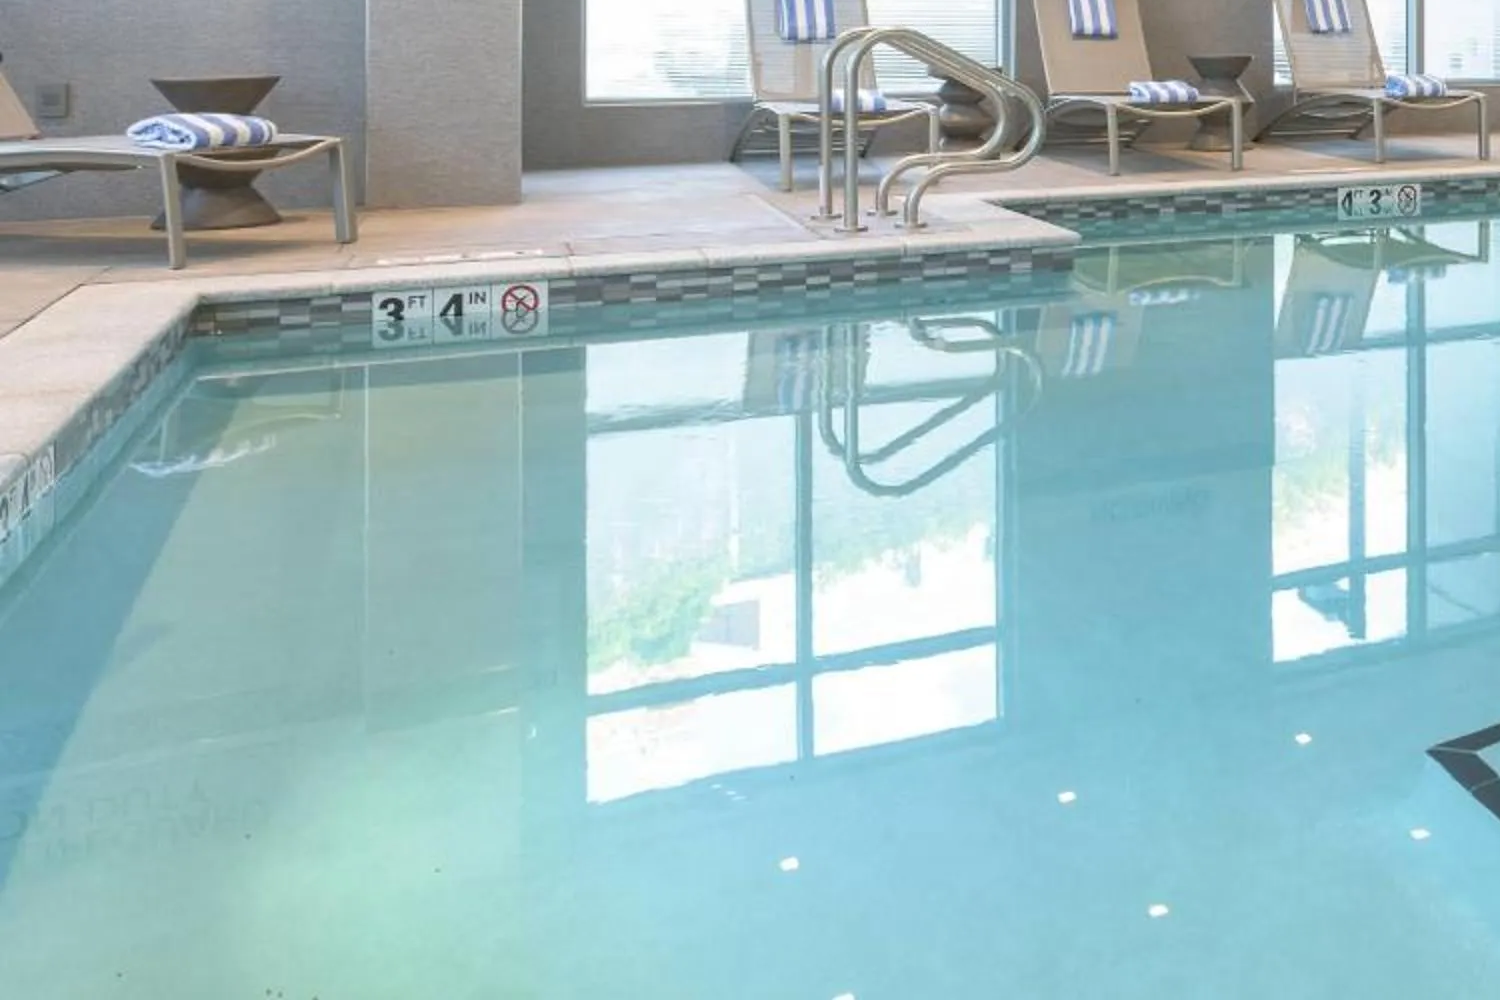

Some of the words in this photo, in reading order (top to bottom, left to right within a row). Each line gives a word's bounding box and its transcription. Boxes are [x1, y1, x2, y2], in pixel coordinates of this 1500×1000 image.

[379, 297, 405, 321] 3
[408, 295, 427, 309] FT
[439, 293, 464, 317] 4
[469, 291, 487, 305] IN
